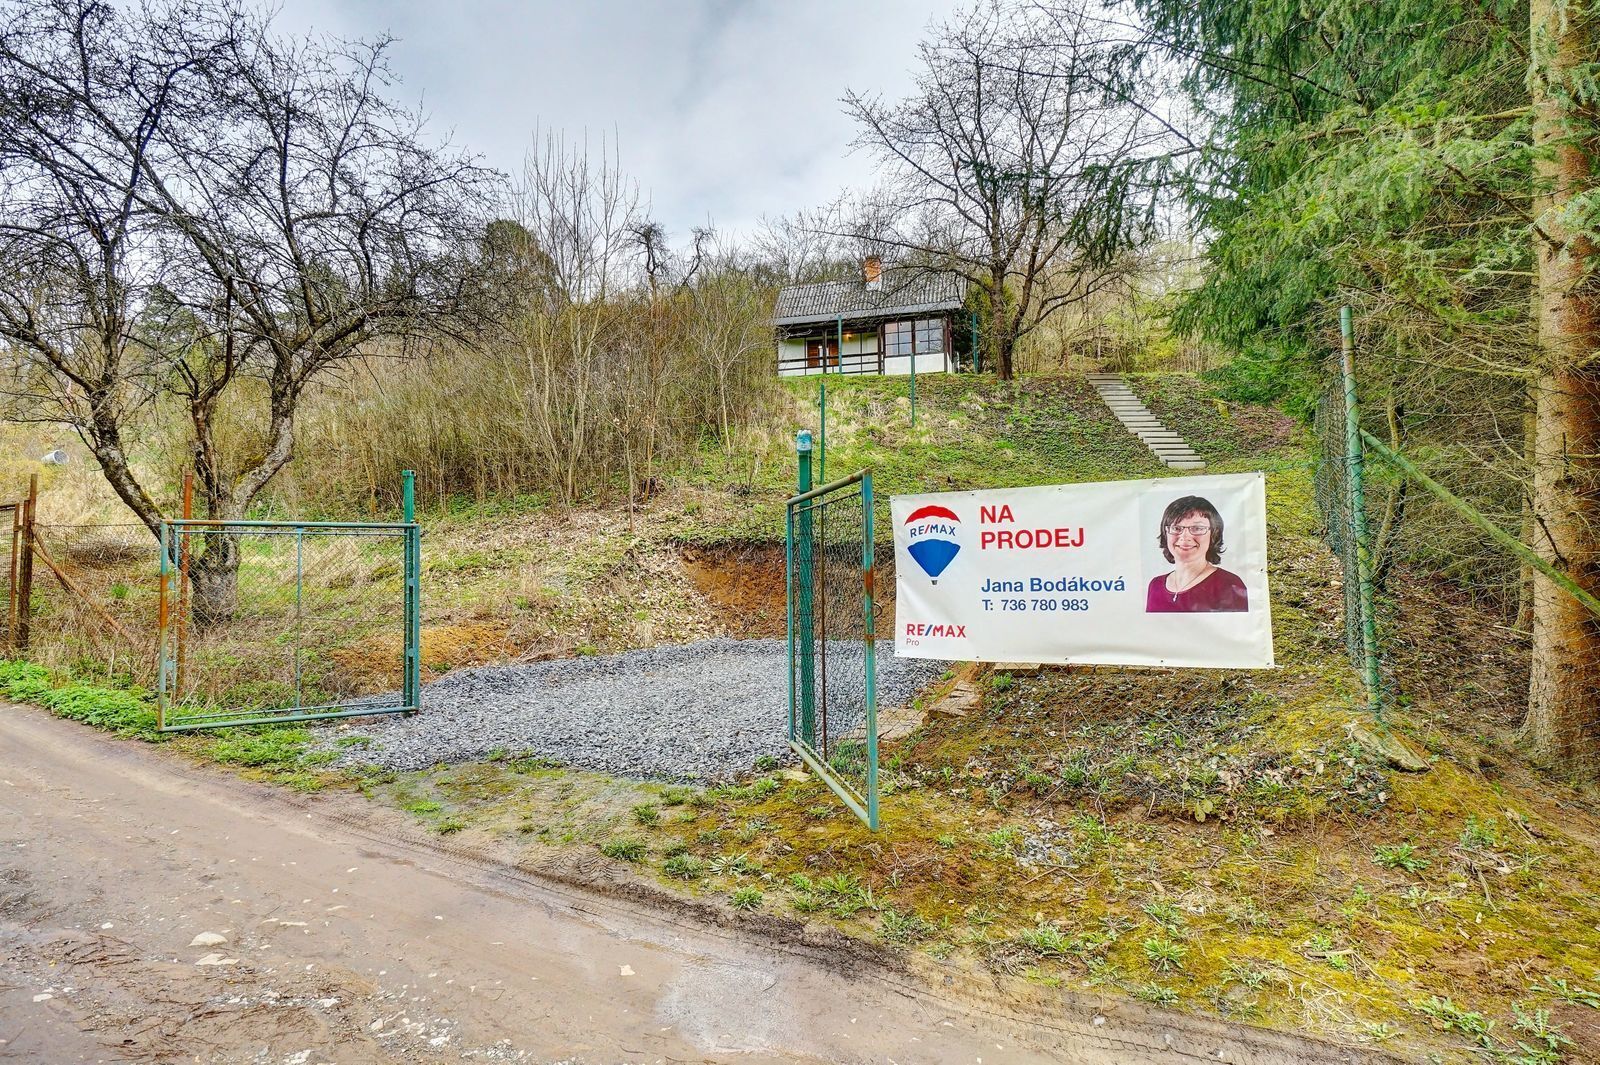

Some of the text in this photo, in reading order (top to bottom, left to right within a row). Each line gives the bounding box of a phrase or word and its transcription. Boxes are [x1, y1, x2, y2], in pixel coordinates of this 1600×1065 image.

[980, 505, 1015, 524] NA
[910, 523, 956, 539] RE/MAX
[980, 528, 1084, 550] PRODEJ
[981, 576, 1125, 592] Jana Bodáková
[982, 599, 1089, 611] T: 736 780 983
[906, 623, 967, 639] RE/MAX
[906, 638, 920, 647] Pro
